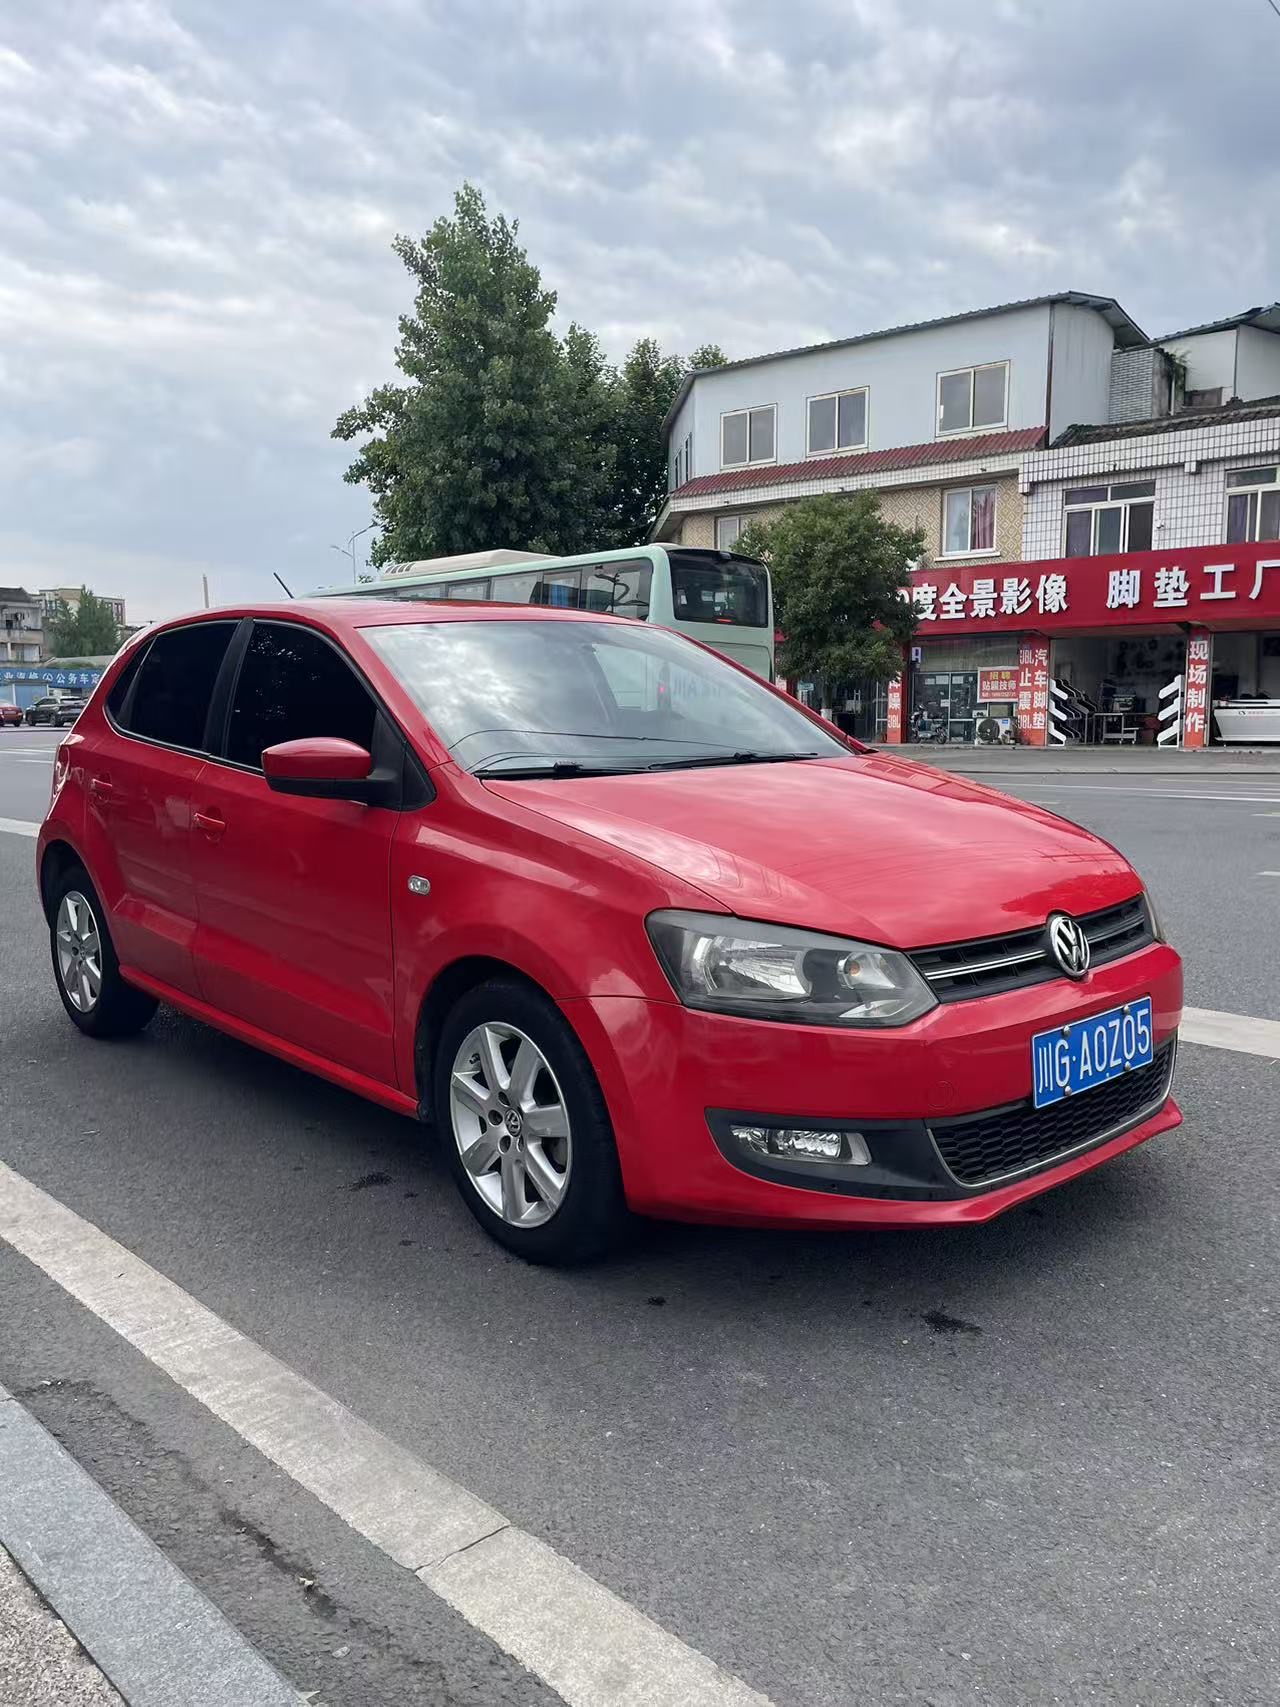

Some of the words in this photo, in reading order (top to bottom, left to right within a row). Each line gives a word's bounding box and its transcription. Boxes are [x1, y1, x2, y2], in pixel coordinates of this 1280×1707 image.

[1106, 560, 1280, 610] 脚垫工厂
[1032, 648, 1048, 729] 汽车脚垫
[1186, 640, 1209, 733] 现场制作
